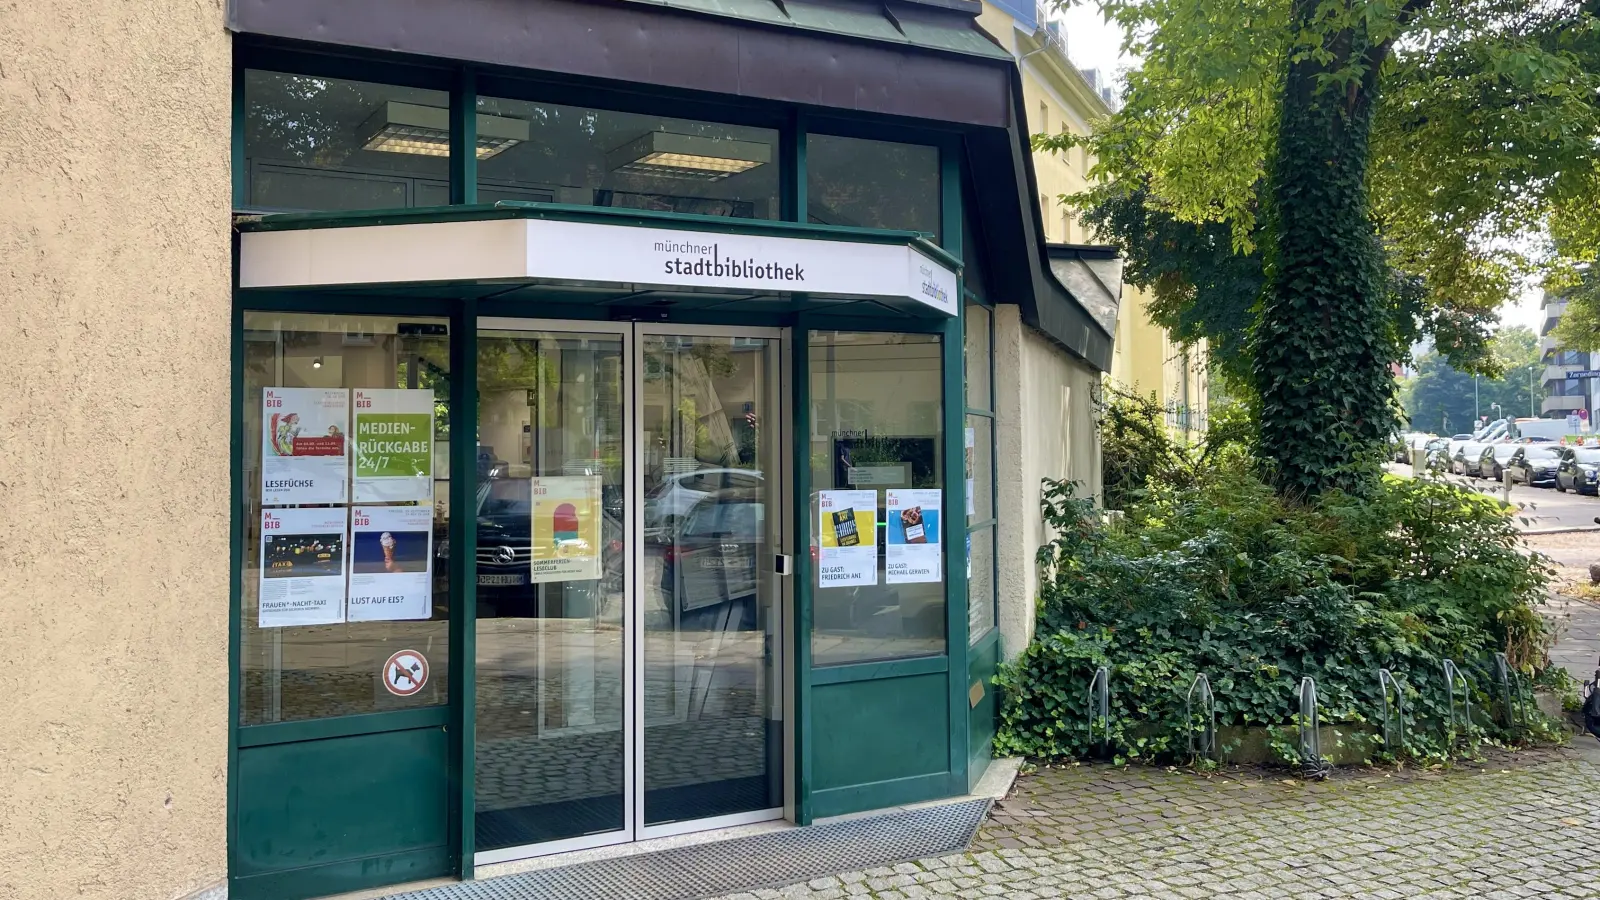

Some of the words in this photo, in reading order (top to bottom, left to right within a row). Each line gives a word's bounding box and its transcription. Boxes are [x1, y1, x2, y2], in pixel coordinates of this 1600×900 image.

[654, 240, 712, 255] münchner
[665, 243, 805, 281] stadtbibliothek
[266, 399, 283, 408] BIB
[356, 400, 372, 408] BIB
[359, 422, 416, 435] MEDIEN-
[831, 428, 865, 437] münchner
[359, 438, 428, 454] RÜCKGABE
[358, 456, 390, 473] 24/7
[265, 478, 314, 488] LESEFÜCHSE
[264, 521, 281, 529] BIB
[354, 518, 370, 526] BIB
[351, 596, 370, 605] LUST
[371, 596, 387, 604] AUF
[388, 595, 405, 604] EIS?
